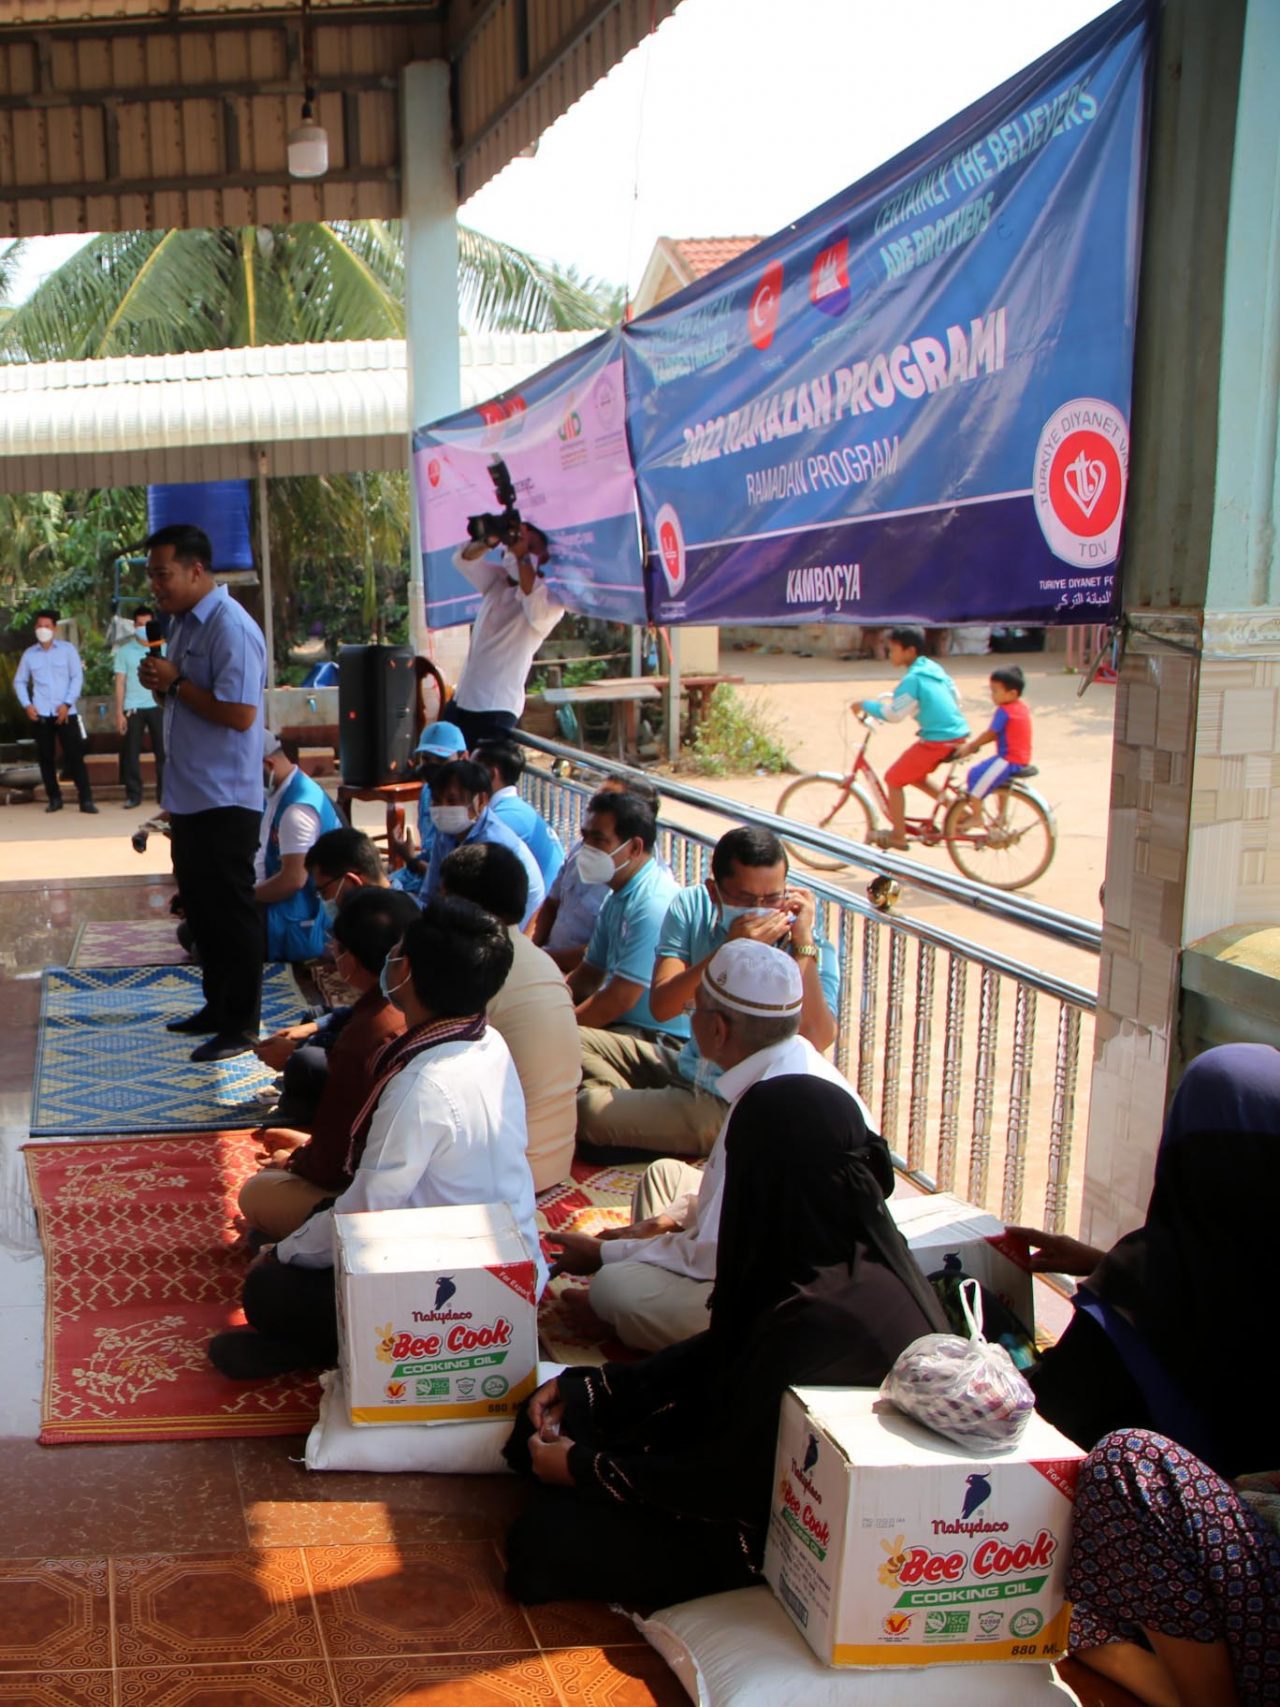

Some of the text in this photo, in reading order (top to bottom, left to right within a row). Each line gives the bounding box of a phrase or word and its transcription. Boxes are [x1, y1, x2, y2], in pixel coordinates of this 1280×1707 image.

[874, 76, 1097, 237] CERTAINLY THE BELIEVERS
[879, 191, 995, 281] ARE BROTHERS
[681, 418, 720, 469] 2022
[722, 373, 832, 454] RAMAZAN
[834, 306, 1008, 422] PROGRAMI
[746, 435, 900, 506] RAMADAN PROGRAM
[1078, 541, 1108, 558] TDV
[786, 563, 861, 611] KAMBOÇYA
[412, 1310, 472, 1324] Nakydaco
[392, 1317, 511, 1359] Bee Cook
[402, 1355, 496, 1375] COOKING OIL
[1046, 1467, 1060, 1483] For
[784, 1483, 830, 1546] Bee Cook
[931, 1519, 1009, 1538] Nakydaco
[897, 1530, 1054, 1583] Bee Cook
[911, 1582, 1032, 1604] COOKING OIL
[947, 1616, 968, 1624] ISO
[1011, 1645, 1036, 1655] 880
